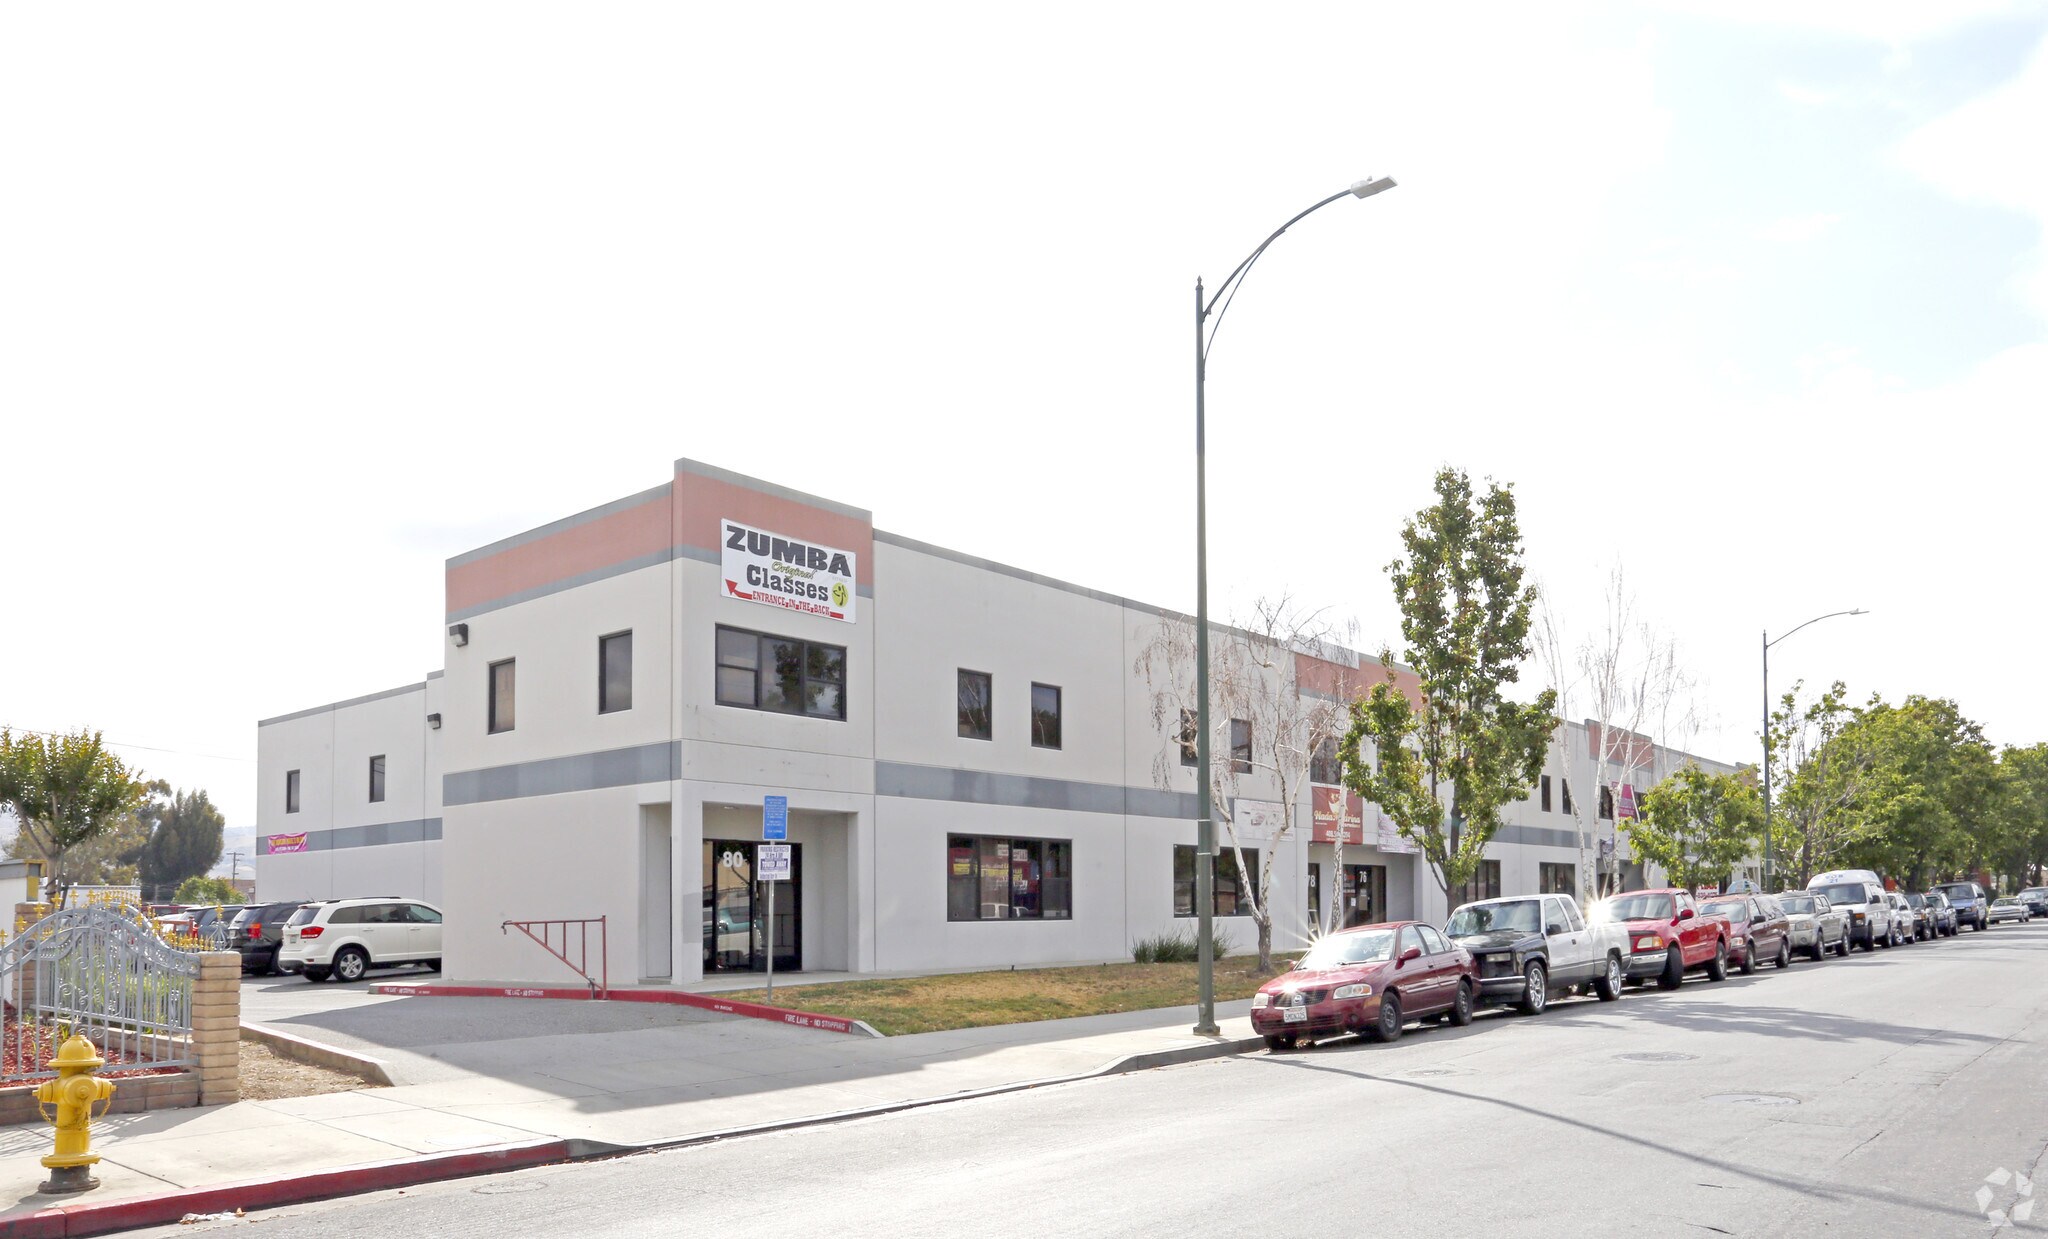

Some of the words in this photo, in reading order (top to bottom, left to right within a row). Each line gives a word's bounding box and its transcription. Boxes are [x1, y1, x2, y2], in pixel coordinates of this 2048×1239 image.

[726, 524, 852, 578] ZUMBA
[771, 561, 818, 581] Original
[746, 563, 829, 602] Classes
[752, 590, 786, 607] ENTRANCE
[788, 598, 796, 609] IN
[798, 600, 811, 612] THE
[813, 604, 830, 616] BACK
[722, 851, 744, 868] 80
[1359, 871, 1368, 883] 76
[785, 1013, 796, 1023] FIRE
[796, 1015, 808, 1026] LANE
[821, 1019, 846, 1031] STOPPING
